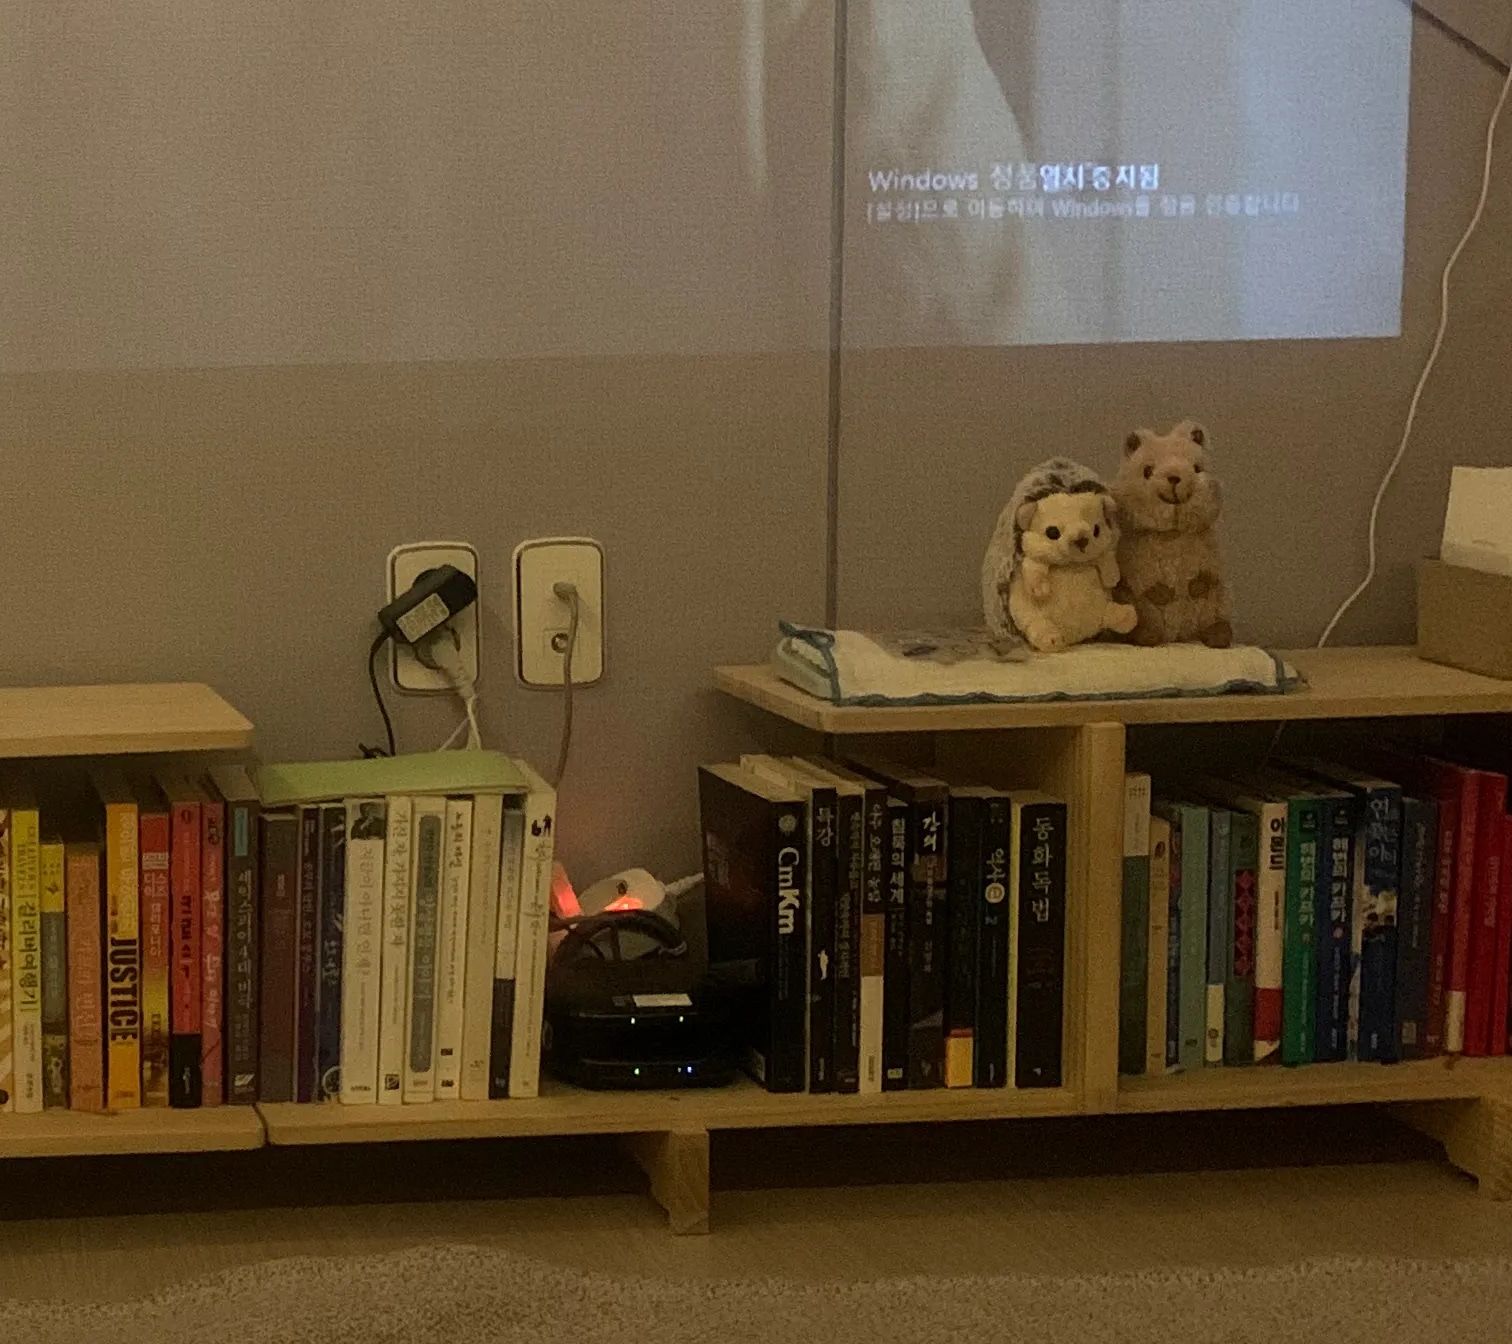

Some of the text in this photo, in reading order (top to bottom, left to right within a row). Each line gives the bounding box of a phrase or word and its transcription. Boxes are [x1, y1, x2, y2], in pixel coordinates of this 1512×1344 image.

[869, 169, 979, 193] Windows
[922, 810, 941, 853] 강의
[778, 846, 799, 935] CmKm
[890, 870, 905, 905] 세계
[1032, 817, 1055, 923] 동화독법
[109, 937, 139, 1042] JUSTICE
